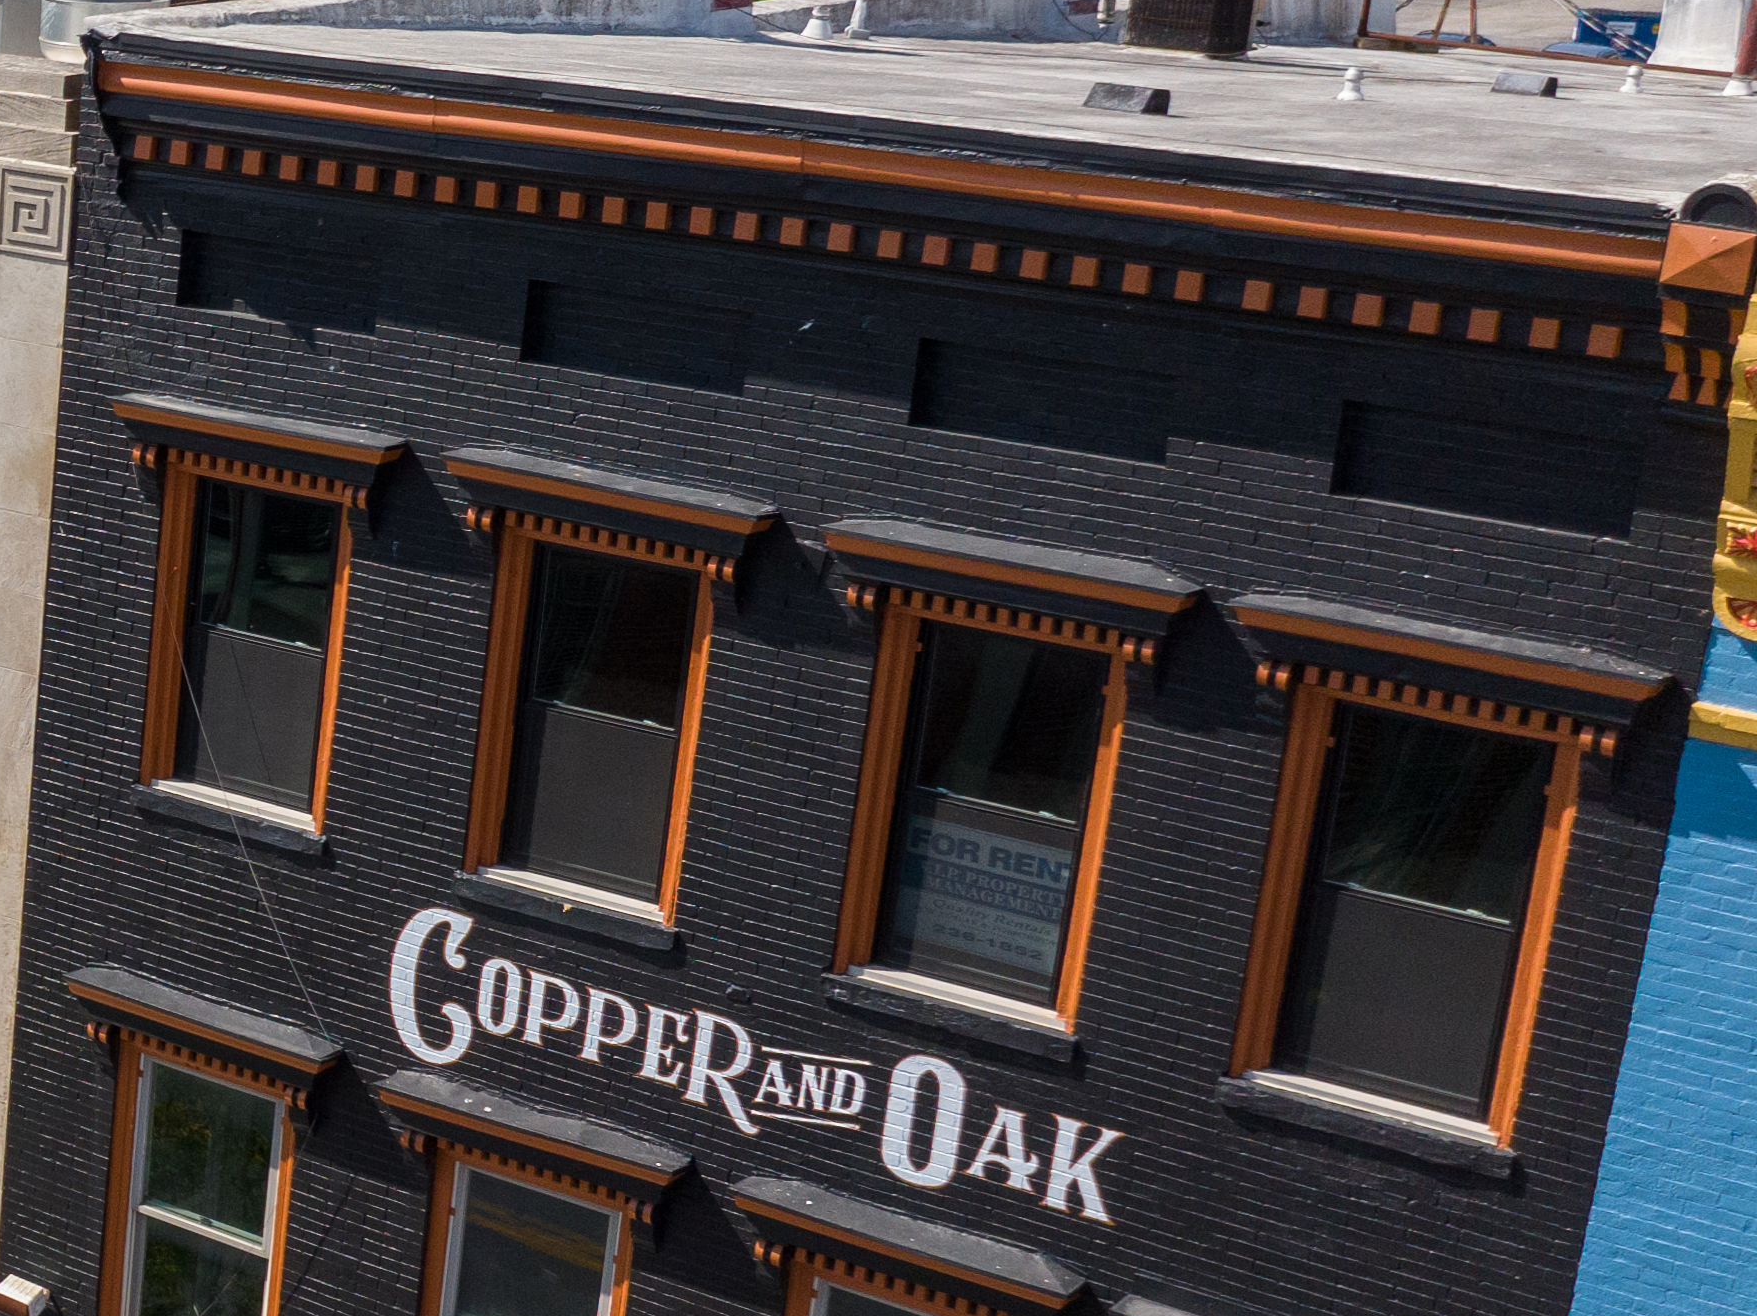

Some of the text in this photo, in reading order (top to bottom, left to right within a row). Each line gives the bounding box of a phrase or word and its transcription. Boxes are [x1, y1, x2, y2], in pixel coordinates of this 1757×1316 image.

[908, 826, 981, 864] FOR
[390, 907, 1125, 1225] COPPER AND OAK
